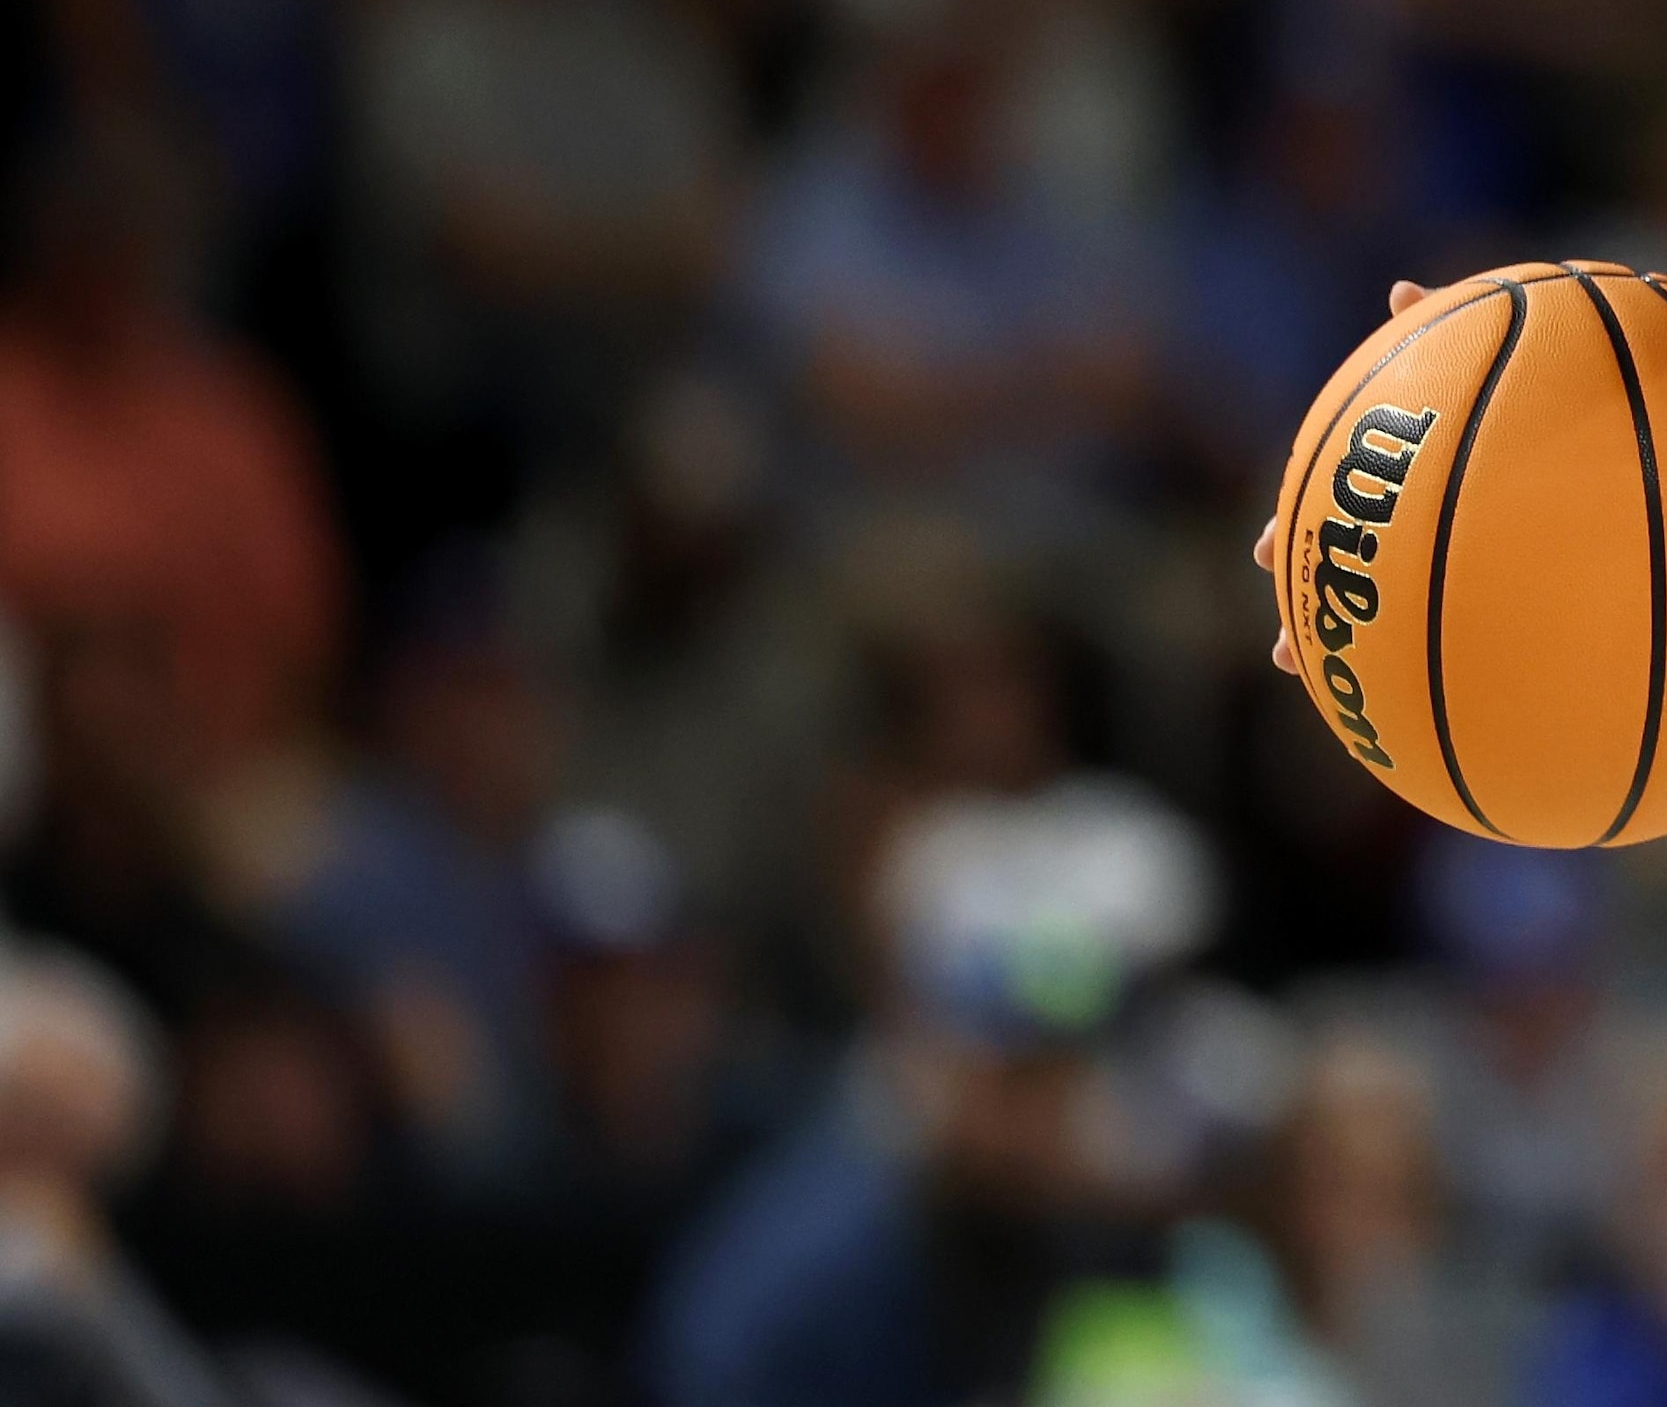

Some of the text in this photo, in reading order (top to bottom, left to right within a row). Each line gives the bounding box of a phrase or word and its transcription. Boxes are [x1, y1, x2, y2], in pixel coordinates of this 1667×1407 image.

[1301, 529, 1314, 647] EVO NXT
[1315, 403, 1440, 770] Wilson
